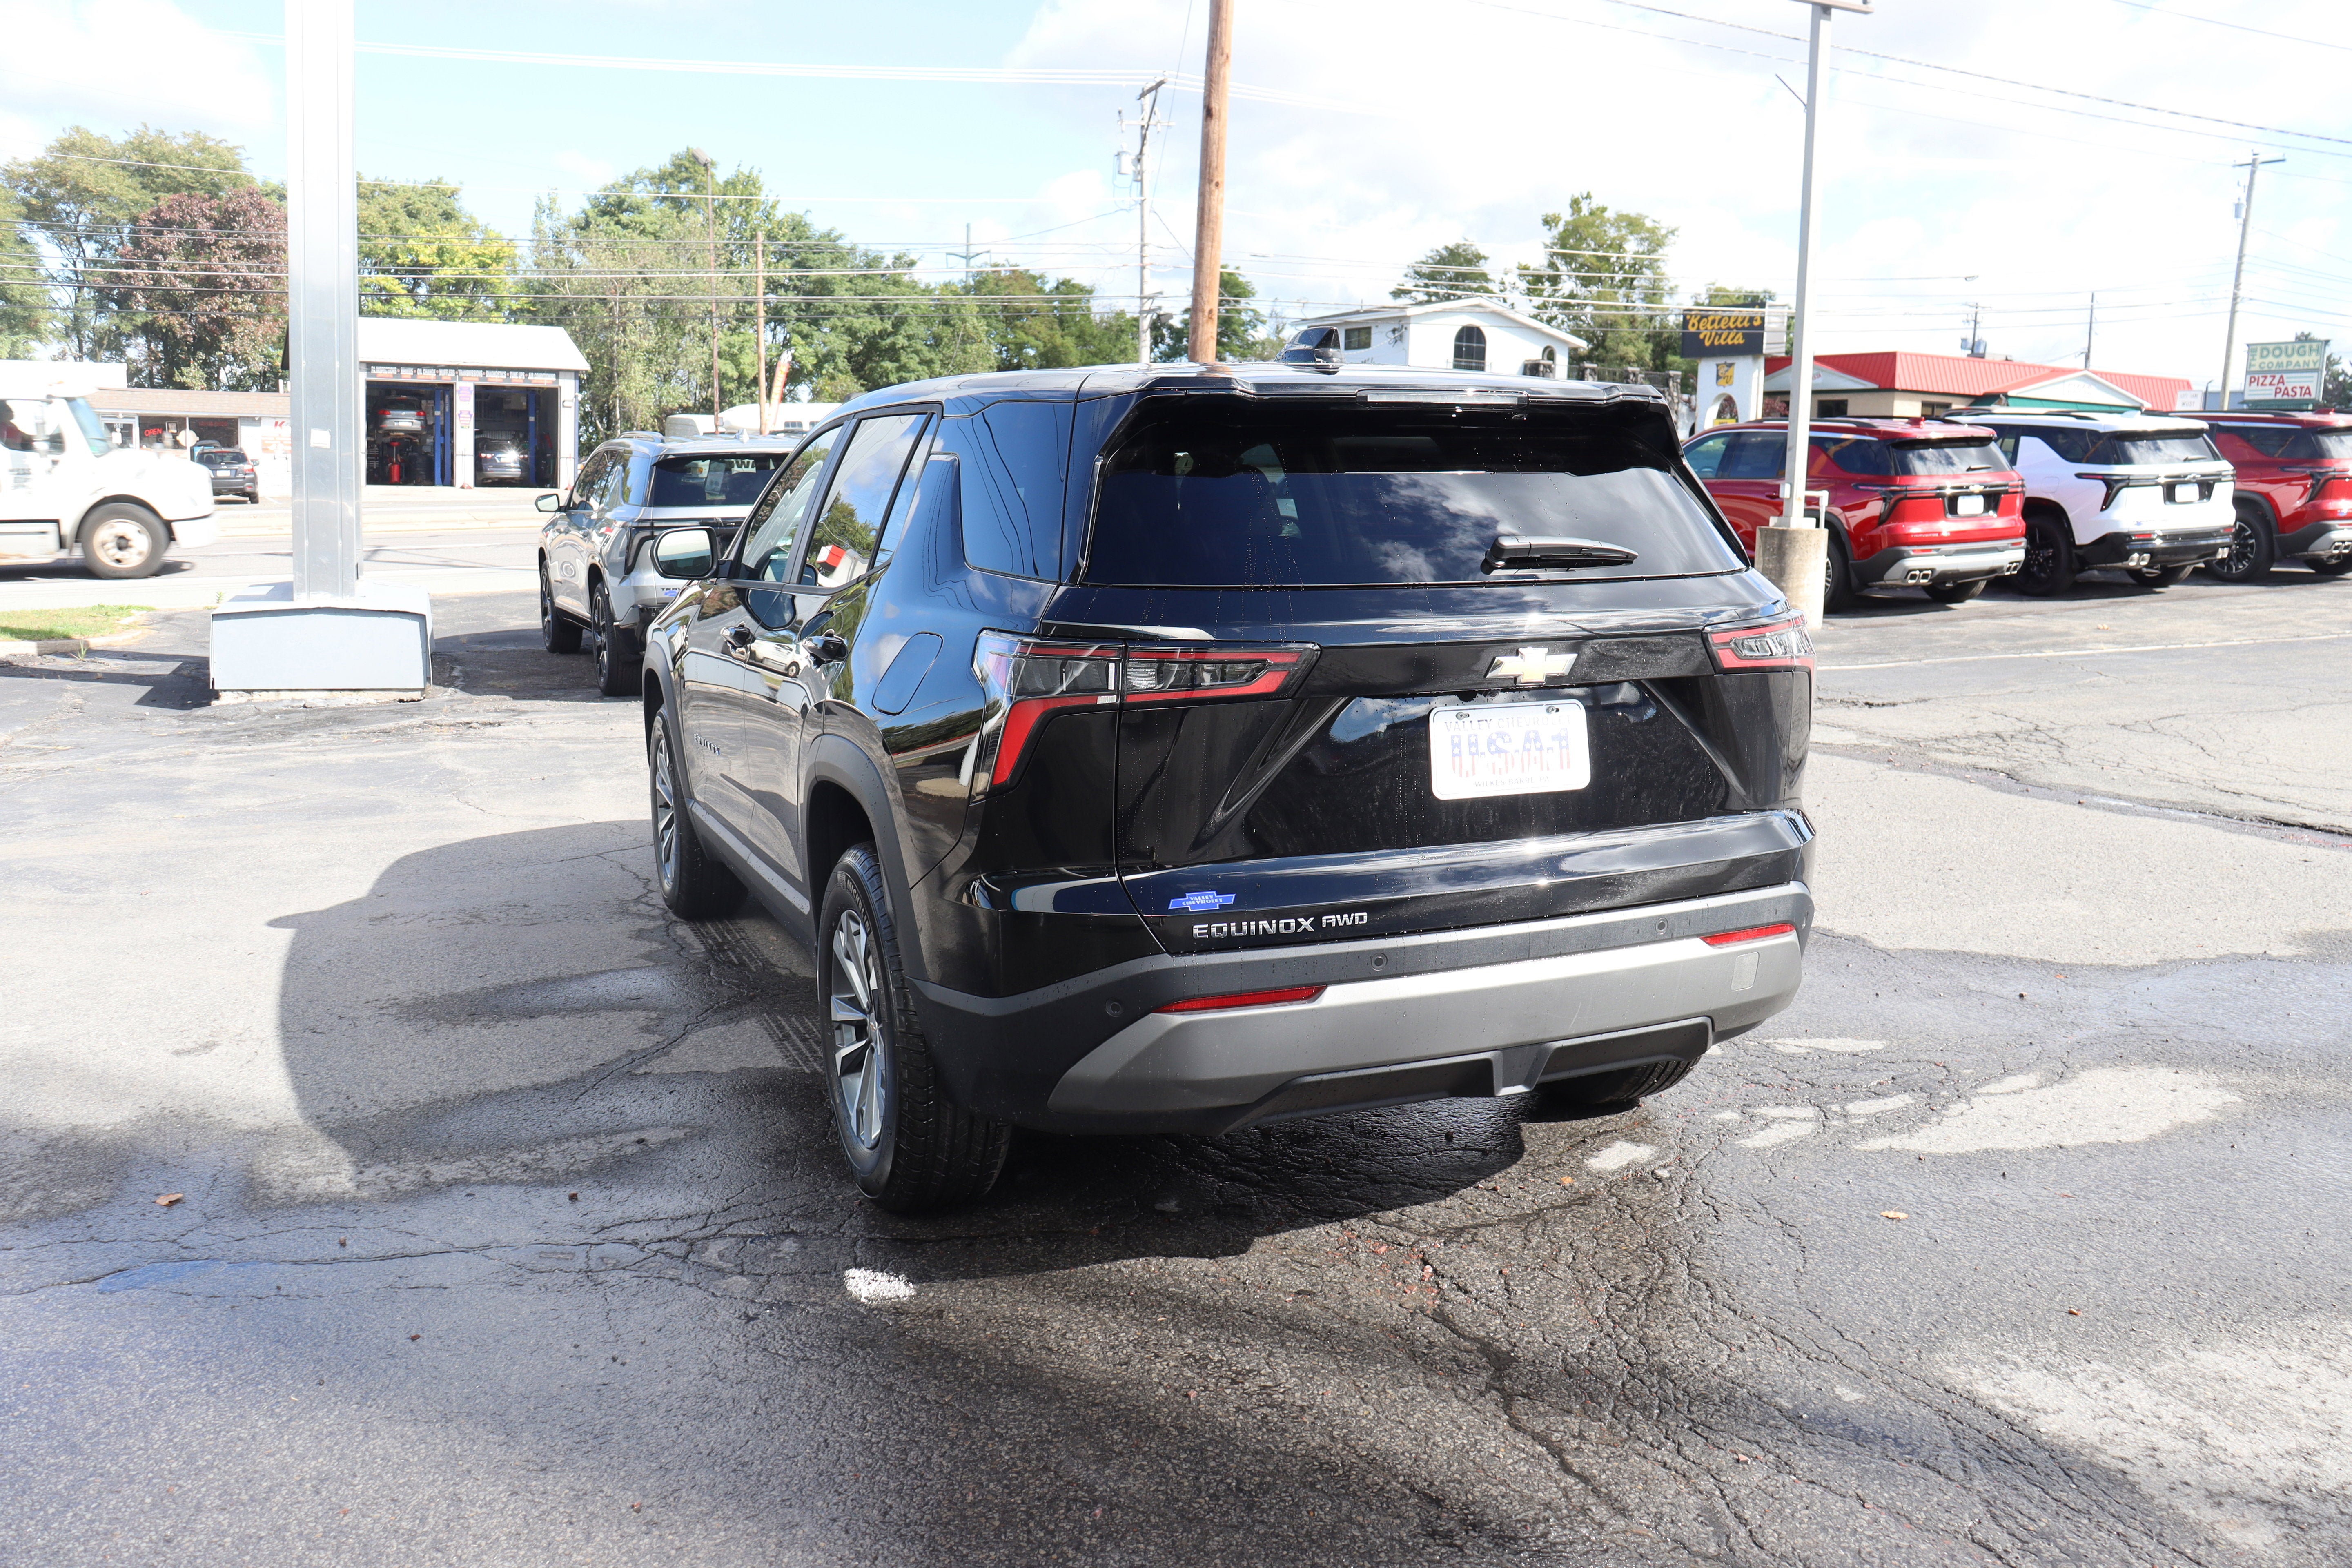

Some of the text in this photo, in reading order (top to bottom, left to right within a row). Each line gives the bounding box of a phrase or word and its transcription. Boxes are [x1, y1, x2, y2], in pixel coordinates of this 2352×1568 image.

[1699, 330, 1746, 347] Villa
[2249, 347, 2258, 370] THE
[2260, 344, 2320, 359] DOUGH
[2258, 359, 2319, 370] COMPANY
[2249, 374, 2285, 387] PIZZA
[2274, 386, 2312, 398] PASTA
[144, 428, 163, 437] OPEN
[1444, 715, 1571, 732] VALLEY CHEVROLET
[1474, 779, 1505, 788] WILKES
[1509, 777, 1534, 785] BARRE
[846, 879, 871, 933] MICHELIN
[1193, 912, 1368, 939] EQUINOX AWD
